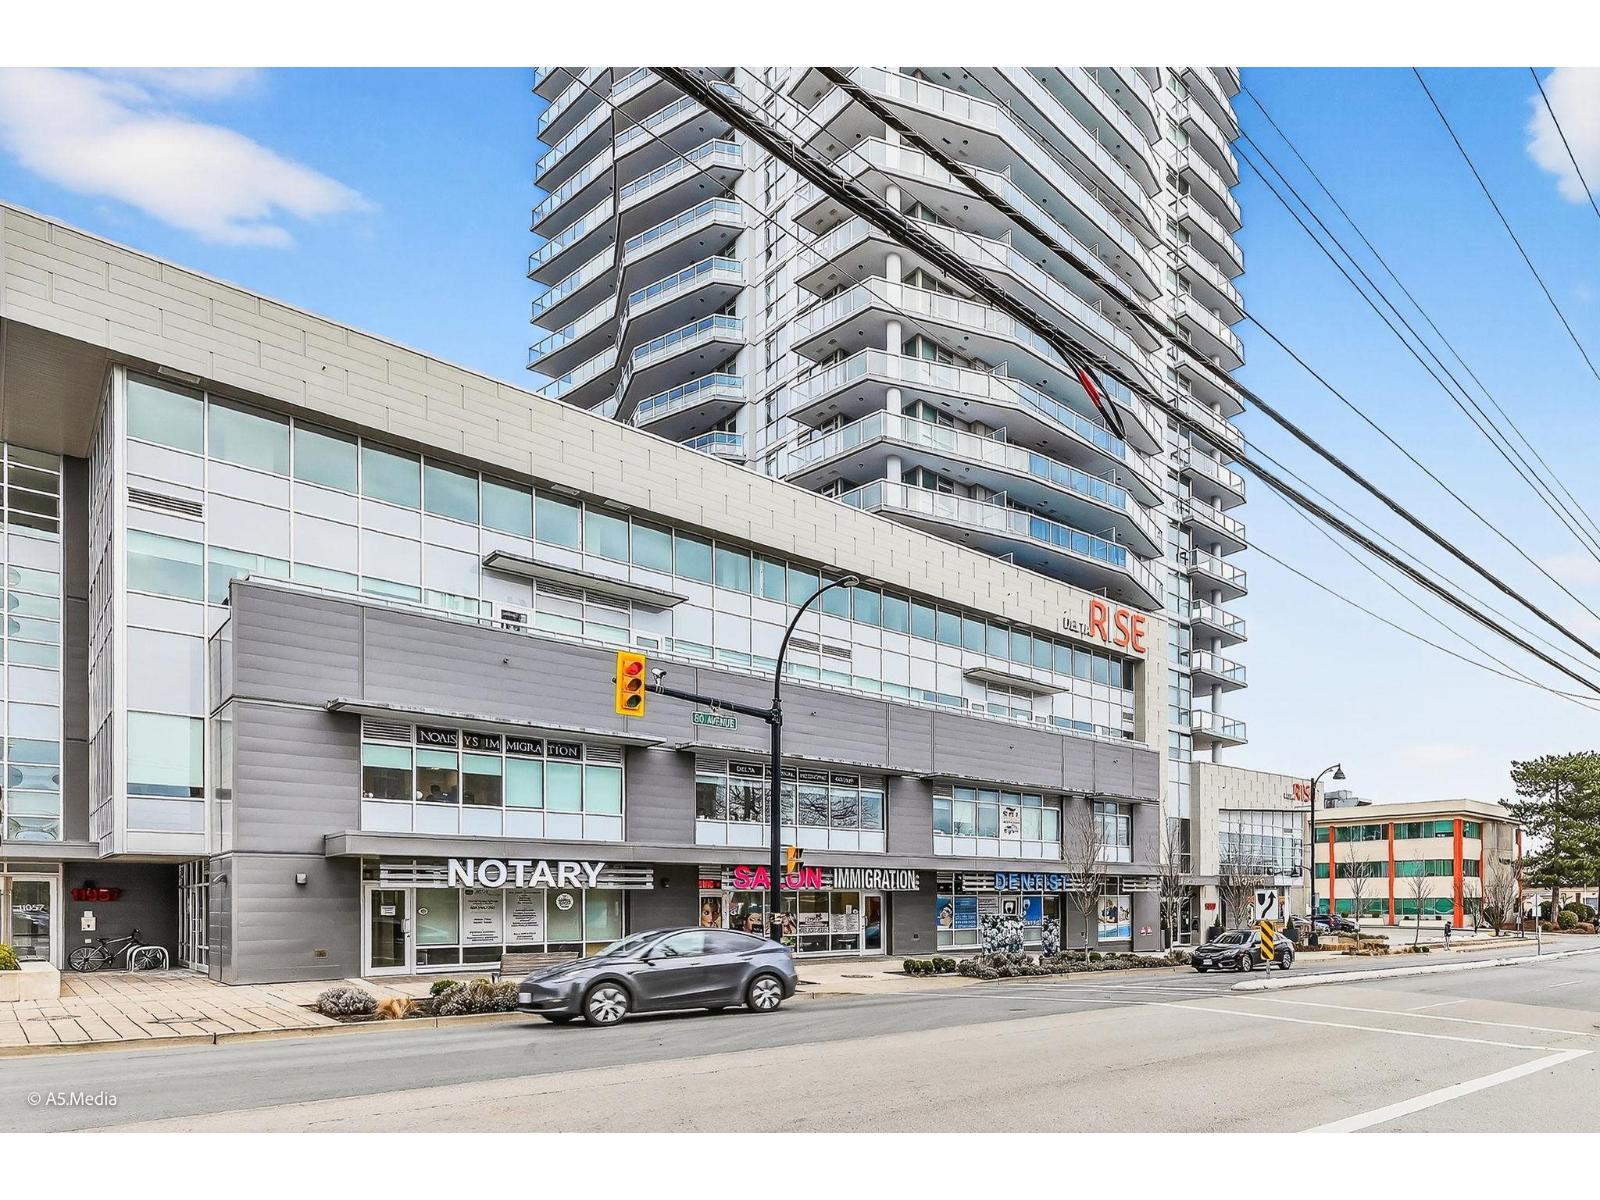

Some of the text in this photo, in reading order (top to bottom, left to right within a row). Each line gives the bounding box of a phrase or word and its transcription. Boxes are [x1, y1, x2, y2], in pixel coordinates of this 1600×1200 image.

[1089, 598, 1146, 654] RISE
[707, 715, 736, 728] AVENUE
[448, 859, 606, 888] NOTARY
[733, 865, 823, 890] SAON
[833, 868, 915, 890] IMMIGRATION
[995, 873, 1070, 891] DENTIST
